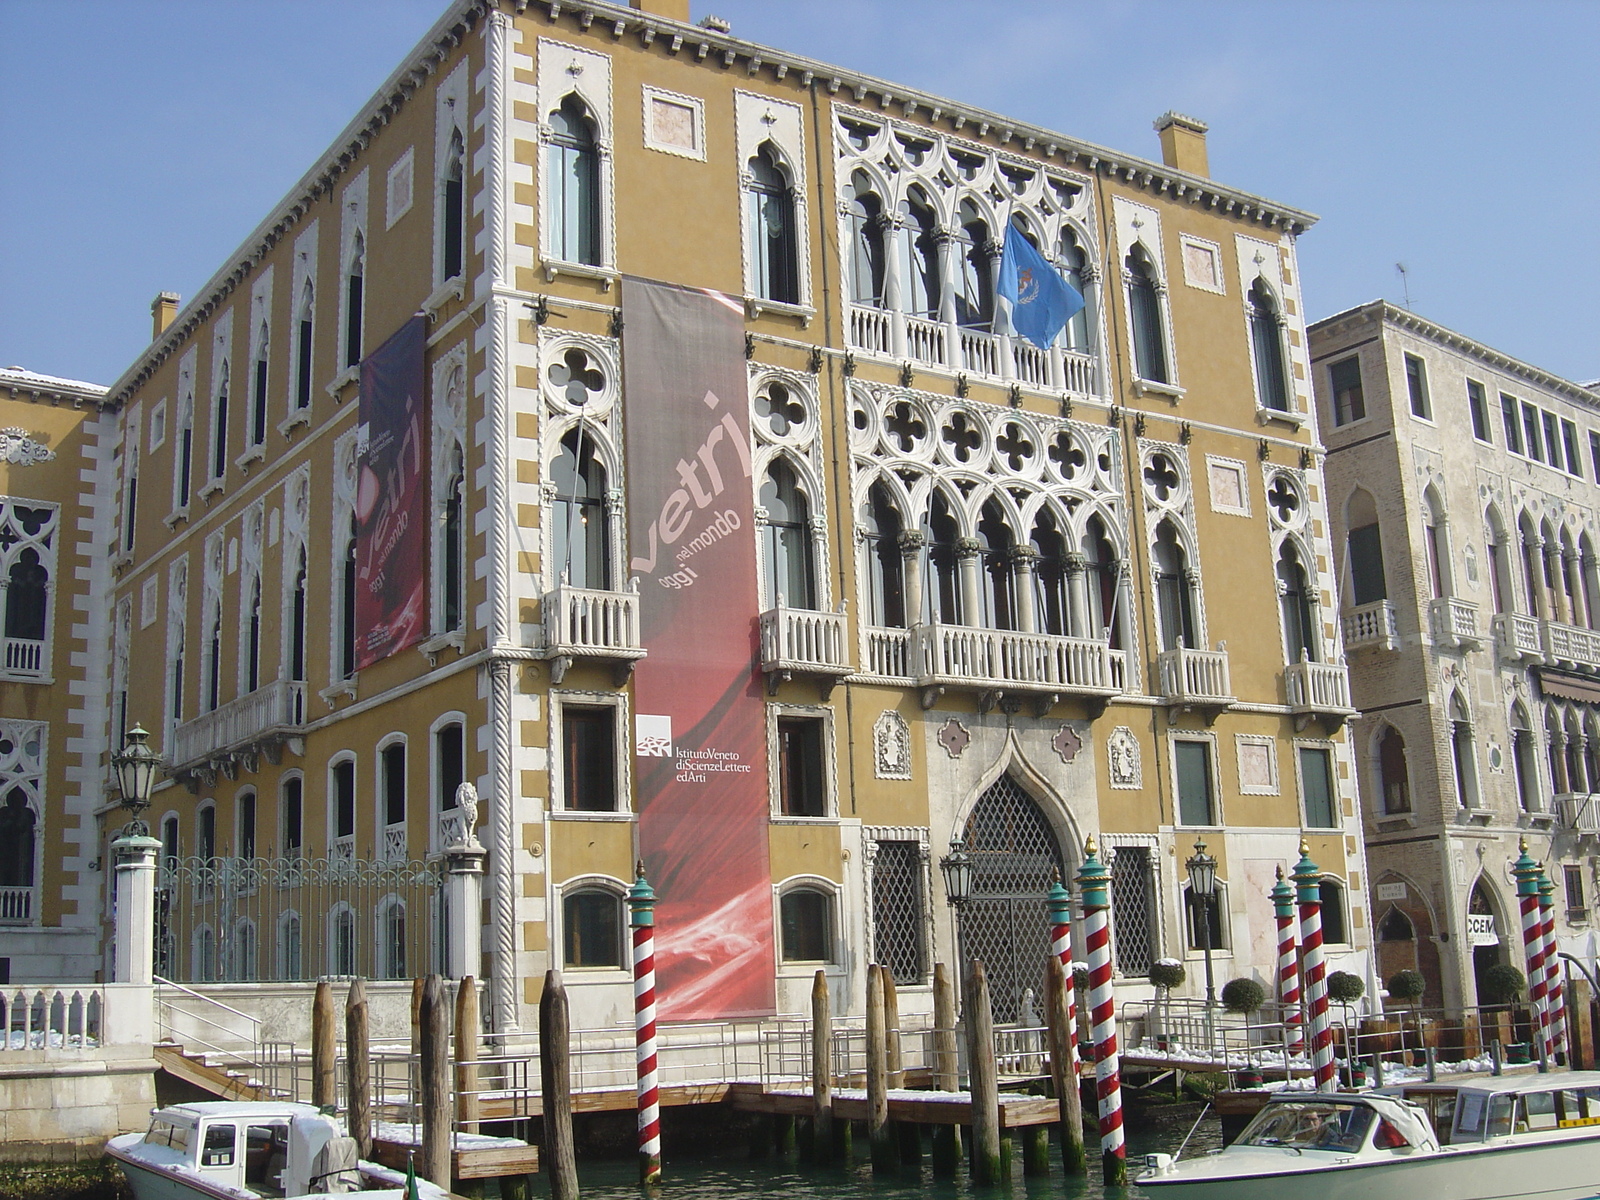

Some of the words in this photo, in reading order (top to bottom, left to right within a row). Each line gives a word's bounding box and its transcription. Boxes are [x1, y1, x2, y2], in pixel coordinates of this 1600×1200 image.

[631, 390, 751, 574] vetri
[384, 510, 409, 557] mondo
[676, 545, 694, 562] nel
[690, 509, 741, 553] mondo
[368, 568, 386, 593] oggi
[658, 563, 699, 590] oggi
